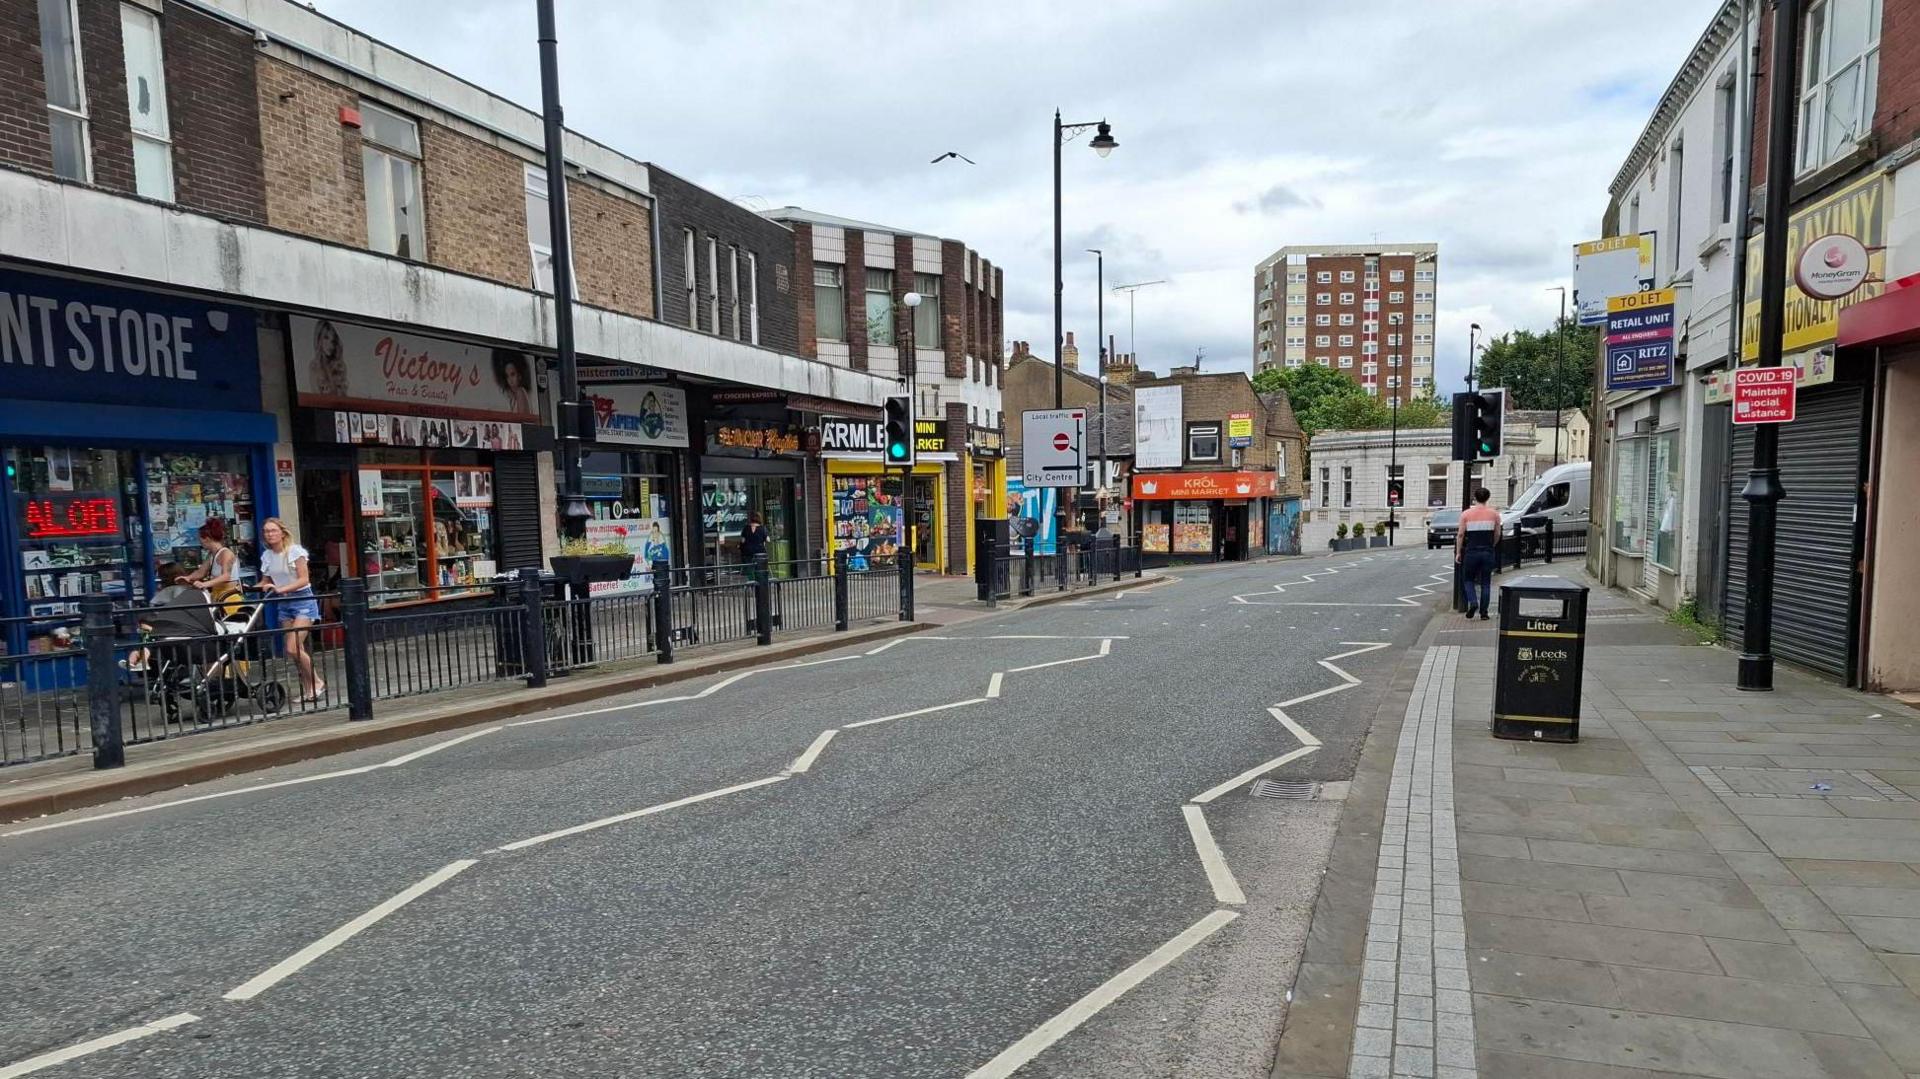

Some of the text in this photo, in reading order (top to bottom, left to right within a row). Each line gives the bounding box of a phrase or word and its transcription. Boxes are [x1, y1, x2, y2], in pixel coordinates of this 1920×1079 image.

[1591, 238, 1627, 253] TO LET
[1811, 271, 1861, 279] MoneyGram
[1620, 297, 1637, 309] TO
[1641, 292, 1661, 305] LET
[1611, 312, 1671, 330] RETAIL UNIT
[66, 302, 198, 381] STORE
[1638, 346, 1667, 359] RITZ
[375, 336, 481, 396] Victory's
[1737, 370, 1793, 383] COVID-19
[386, 381, 408, 396] Hair
[1741, 387, 1788, 397] Maintain
[1740, 409, 1787, 418] stance
[916, 422, 936, 433] MINI
[821, 421, 884, 449] ARMLE
[916, 438, 945, 451] RKET
[1026, 473, 1073, 482] City Centre
[1171, 487, 1230, 497] MINI MARKET
[588, 582, 619, 593] Batteries
[1527, 620, 1558, 631] Litter
[1535, 649, 1568, 659] Leeds
